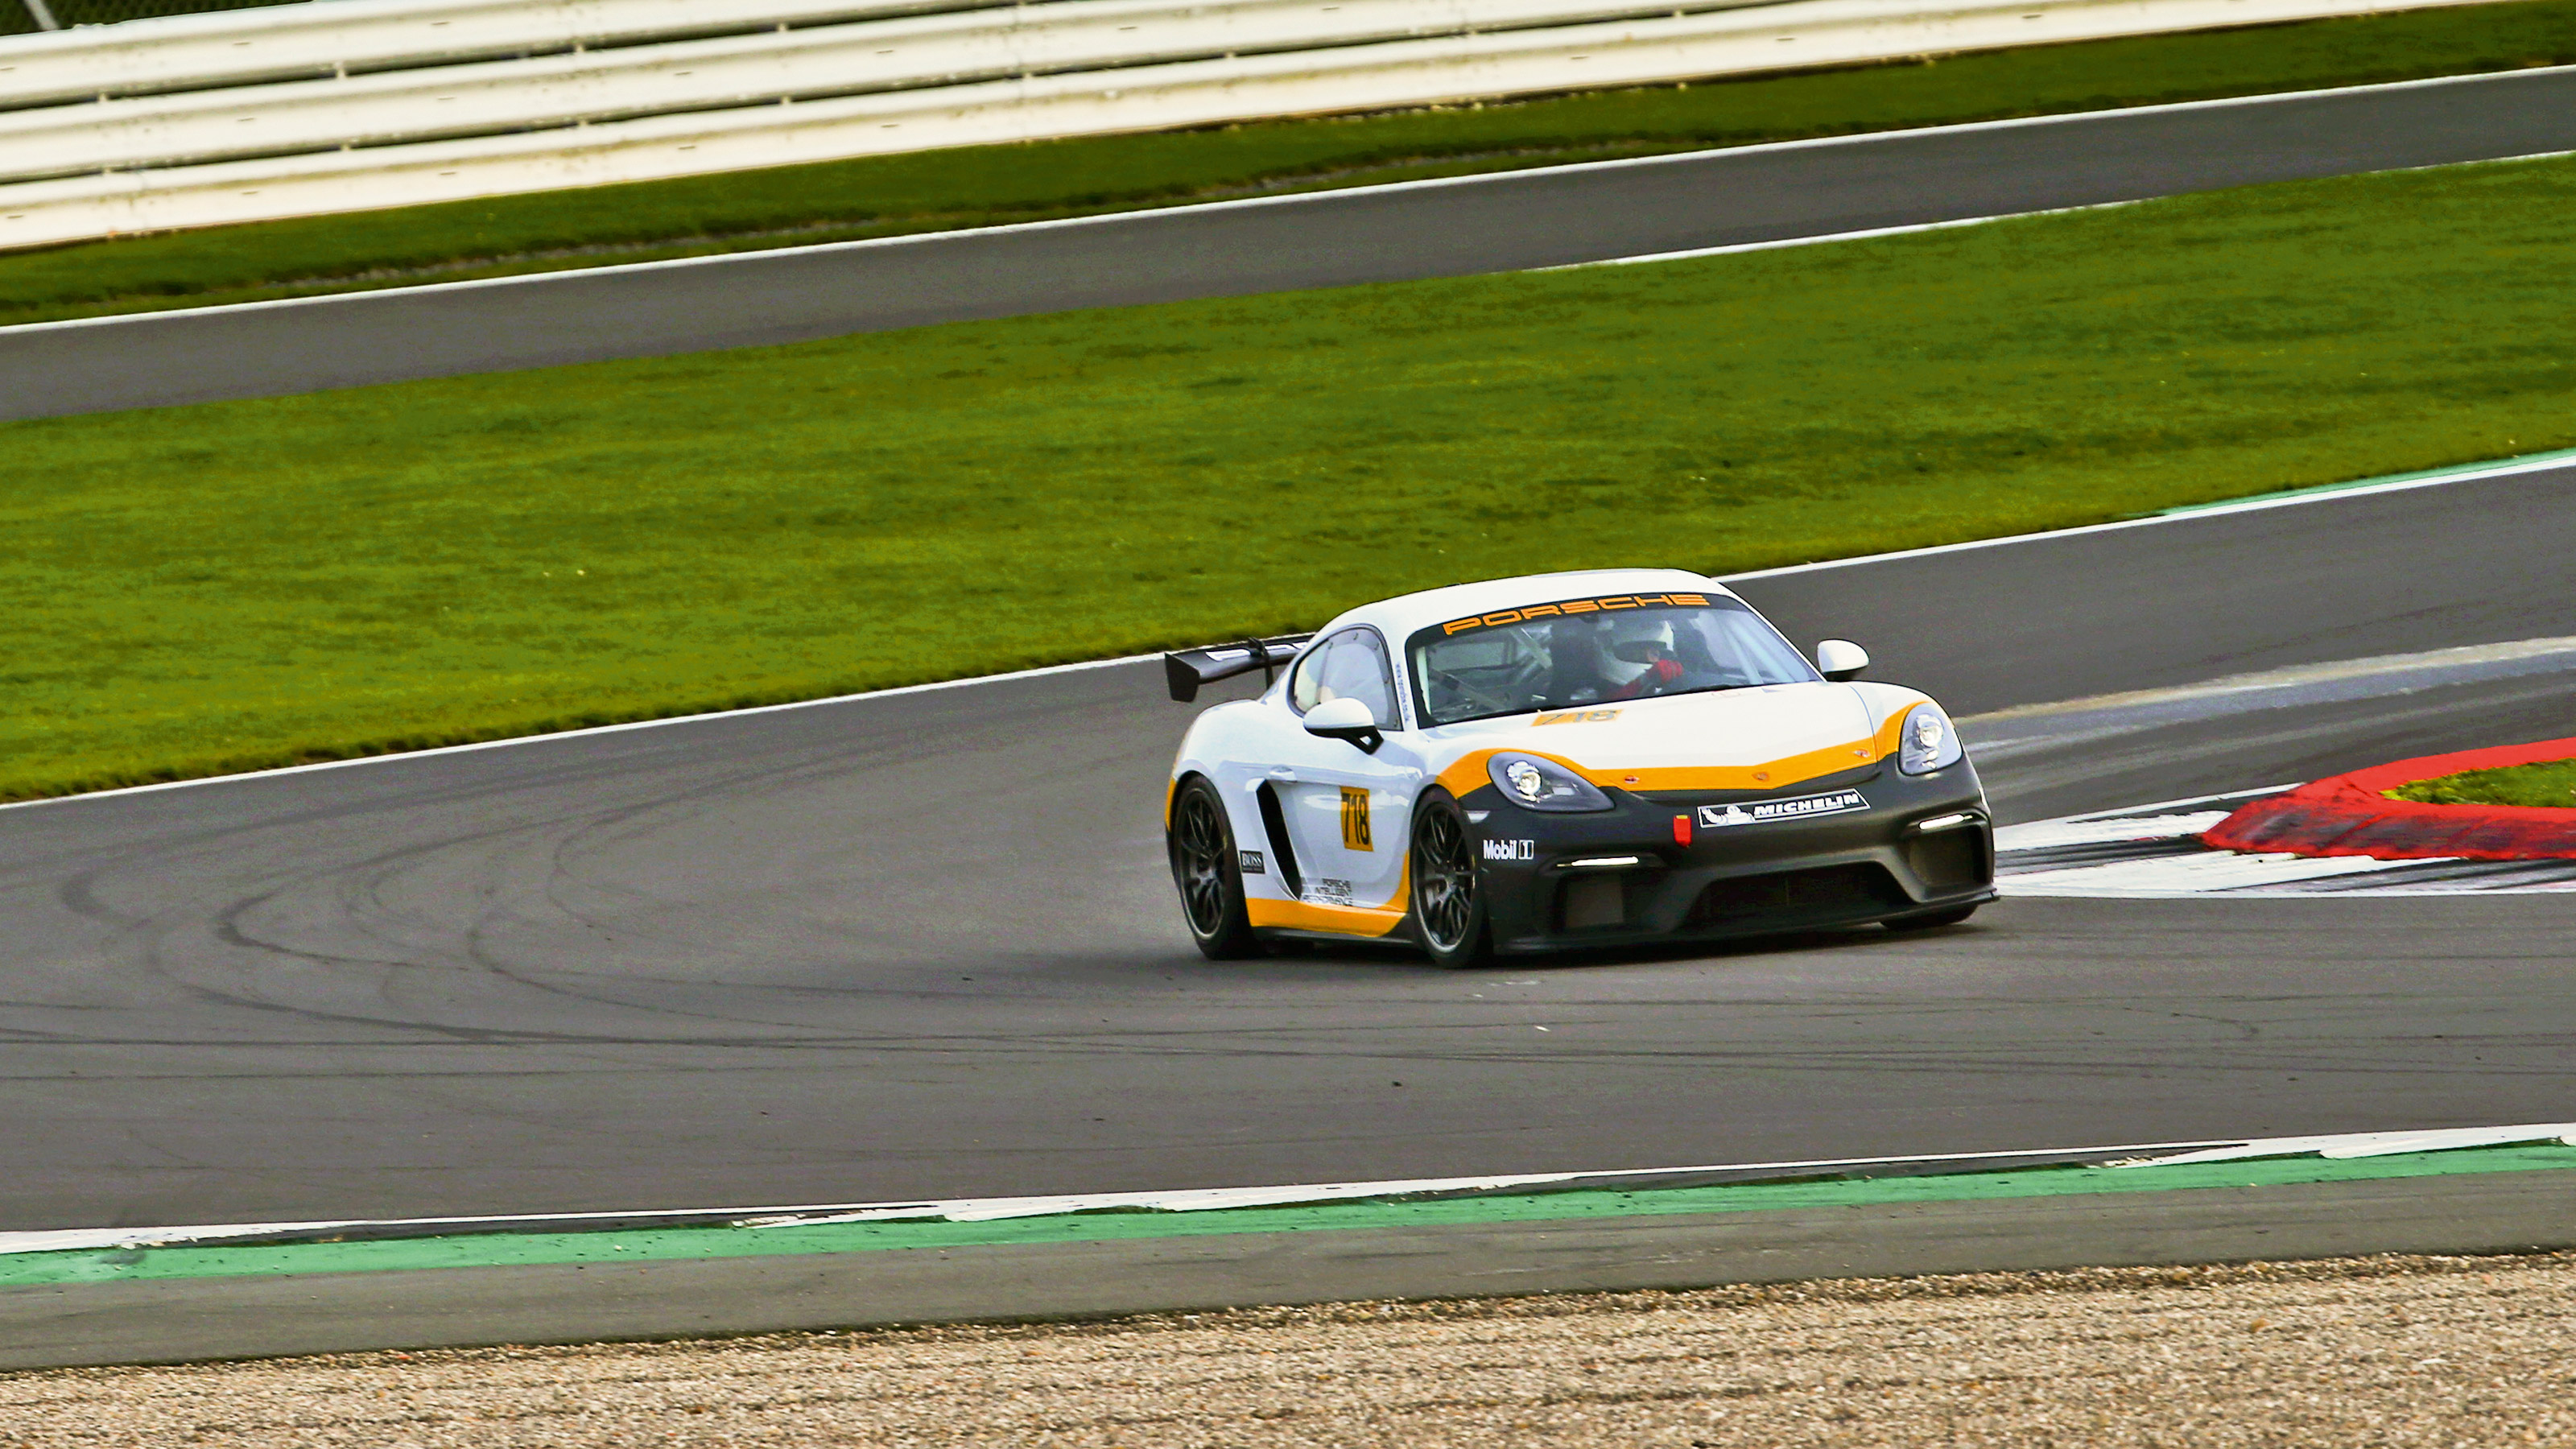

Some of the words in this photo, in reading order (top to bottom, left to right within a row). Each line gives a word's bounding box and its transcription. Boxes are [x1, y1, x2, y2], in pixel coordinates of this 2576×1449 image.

[1443, 594, 1710, 635] PORSCHE
[1754, 794, 1860, 815] MICHELIN
[1341, 793, 1370, 845] 718
[1242, 852, 1263, 867] BOSS
[1483, 840, 1517, 860] Mobil
